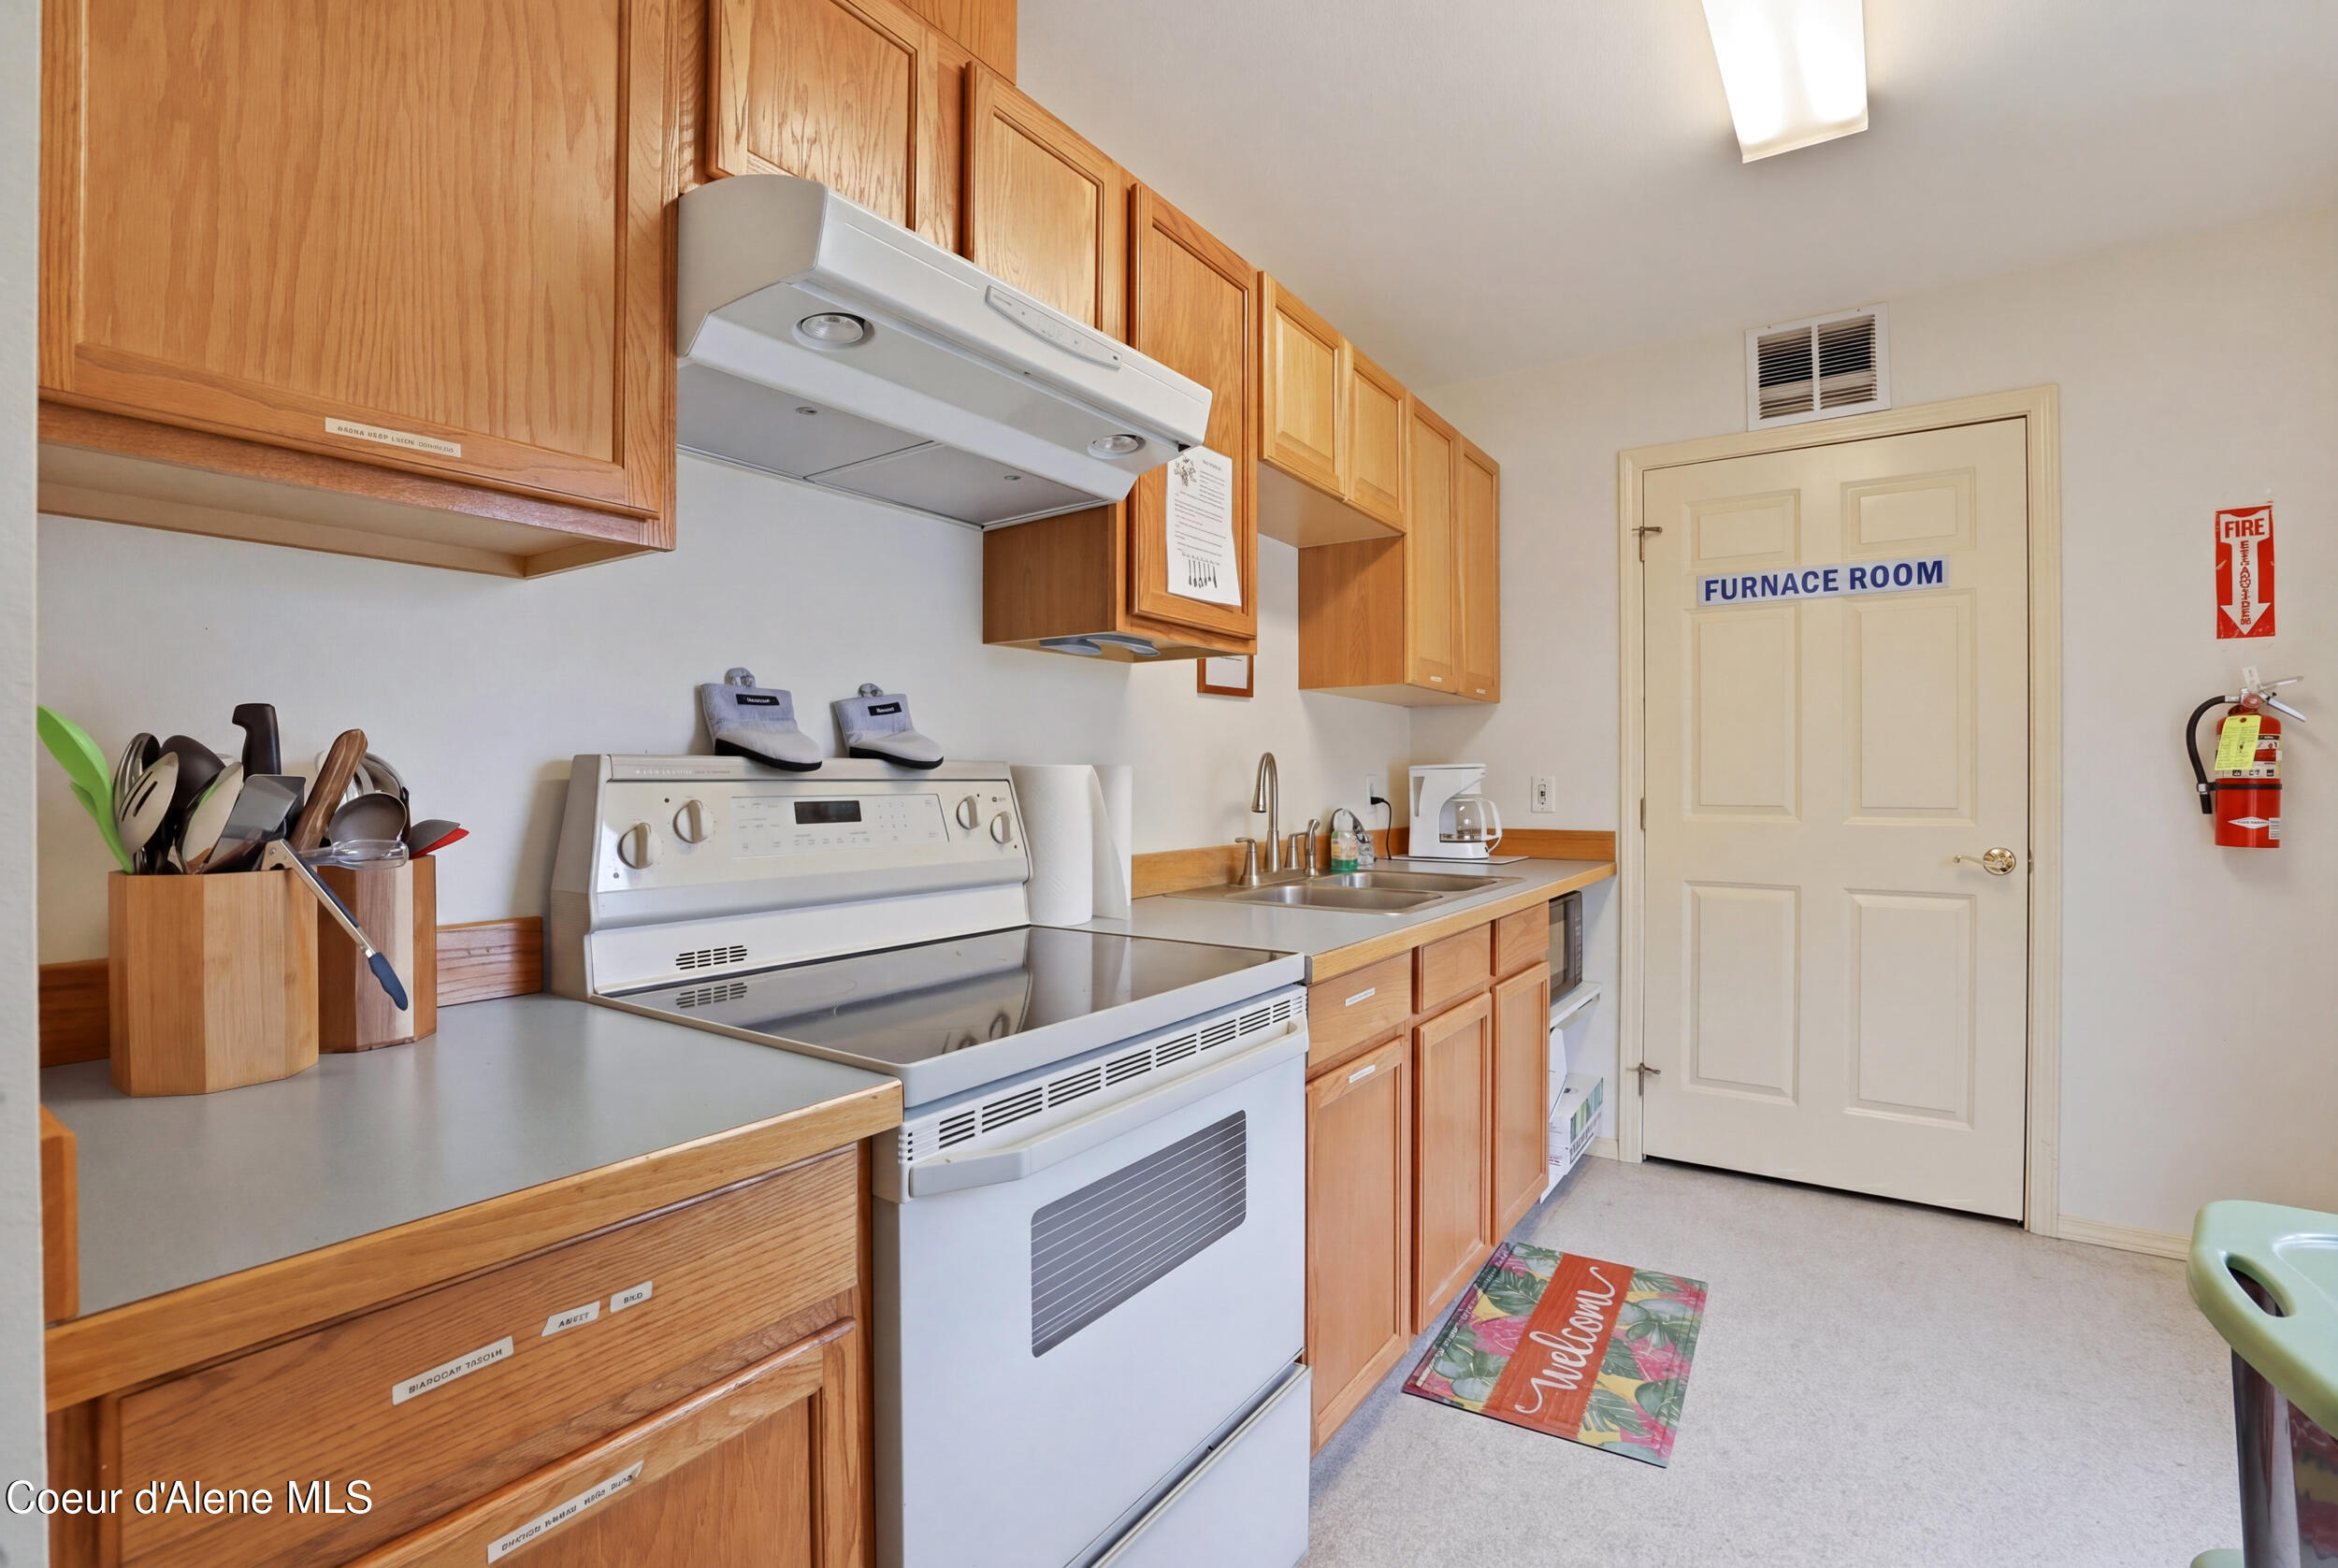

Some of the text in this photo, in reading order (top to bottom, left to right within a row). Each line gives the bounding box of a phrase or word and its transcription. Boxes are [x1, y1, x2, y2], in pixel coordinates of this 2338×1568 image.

[2225, 517, 2265, 539] FIRE
[1705, 560, 1943, 601] FURNACE ROOM
